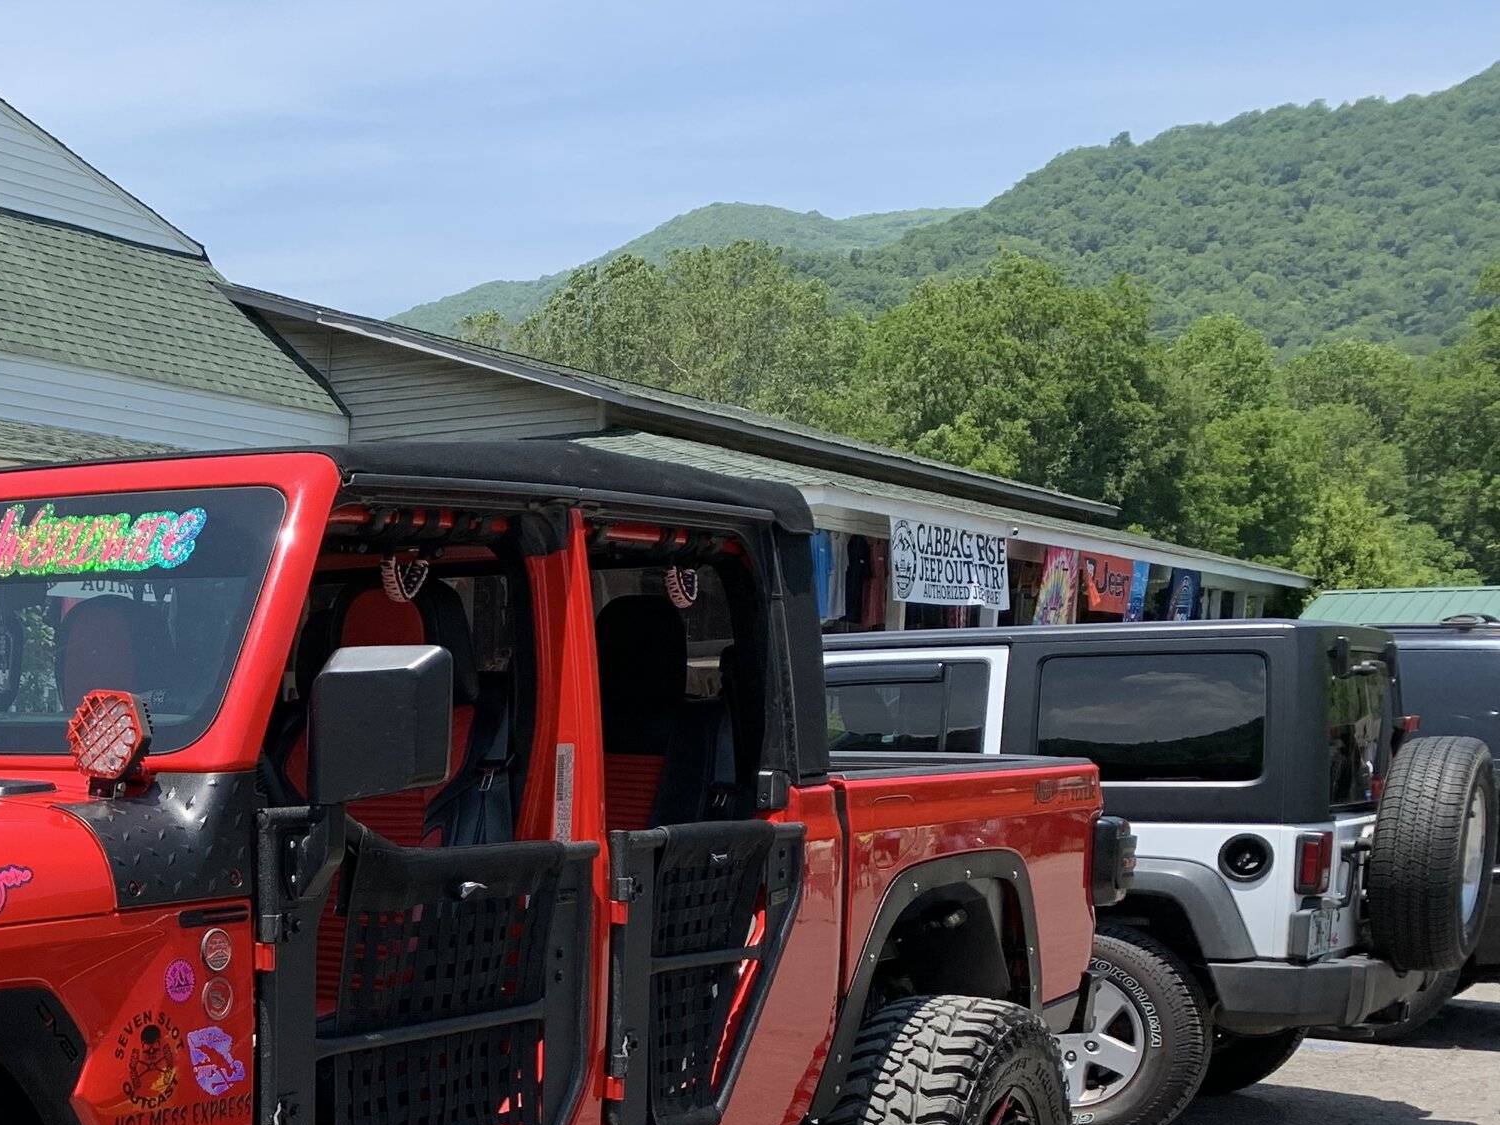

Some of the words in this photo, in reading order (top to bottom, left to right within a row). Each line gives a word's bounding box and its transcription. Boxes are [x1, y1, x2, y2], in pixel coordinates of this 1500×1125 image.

[919, 556, 944, 583] JEEP
[923, 583, 971, 600] AUTHORIZED
[114, 1010, 153, 1060] SEVEN
[157, 1011, 185, 1051] SLOT
[122, 1077, 180, 1110] OUTCAST
[192, 1092, 251, 1125] EXPRESS
